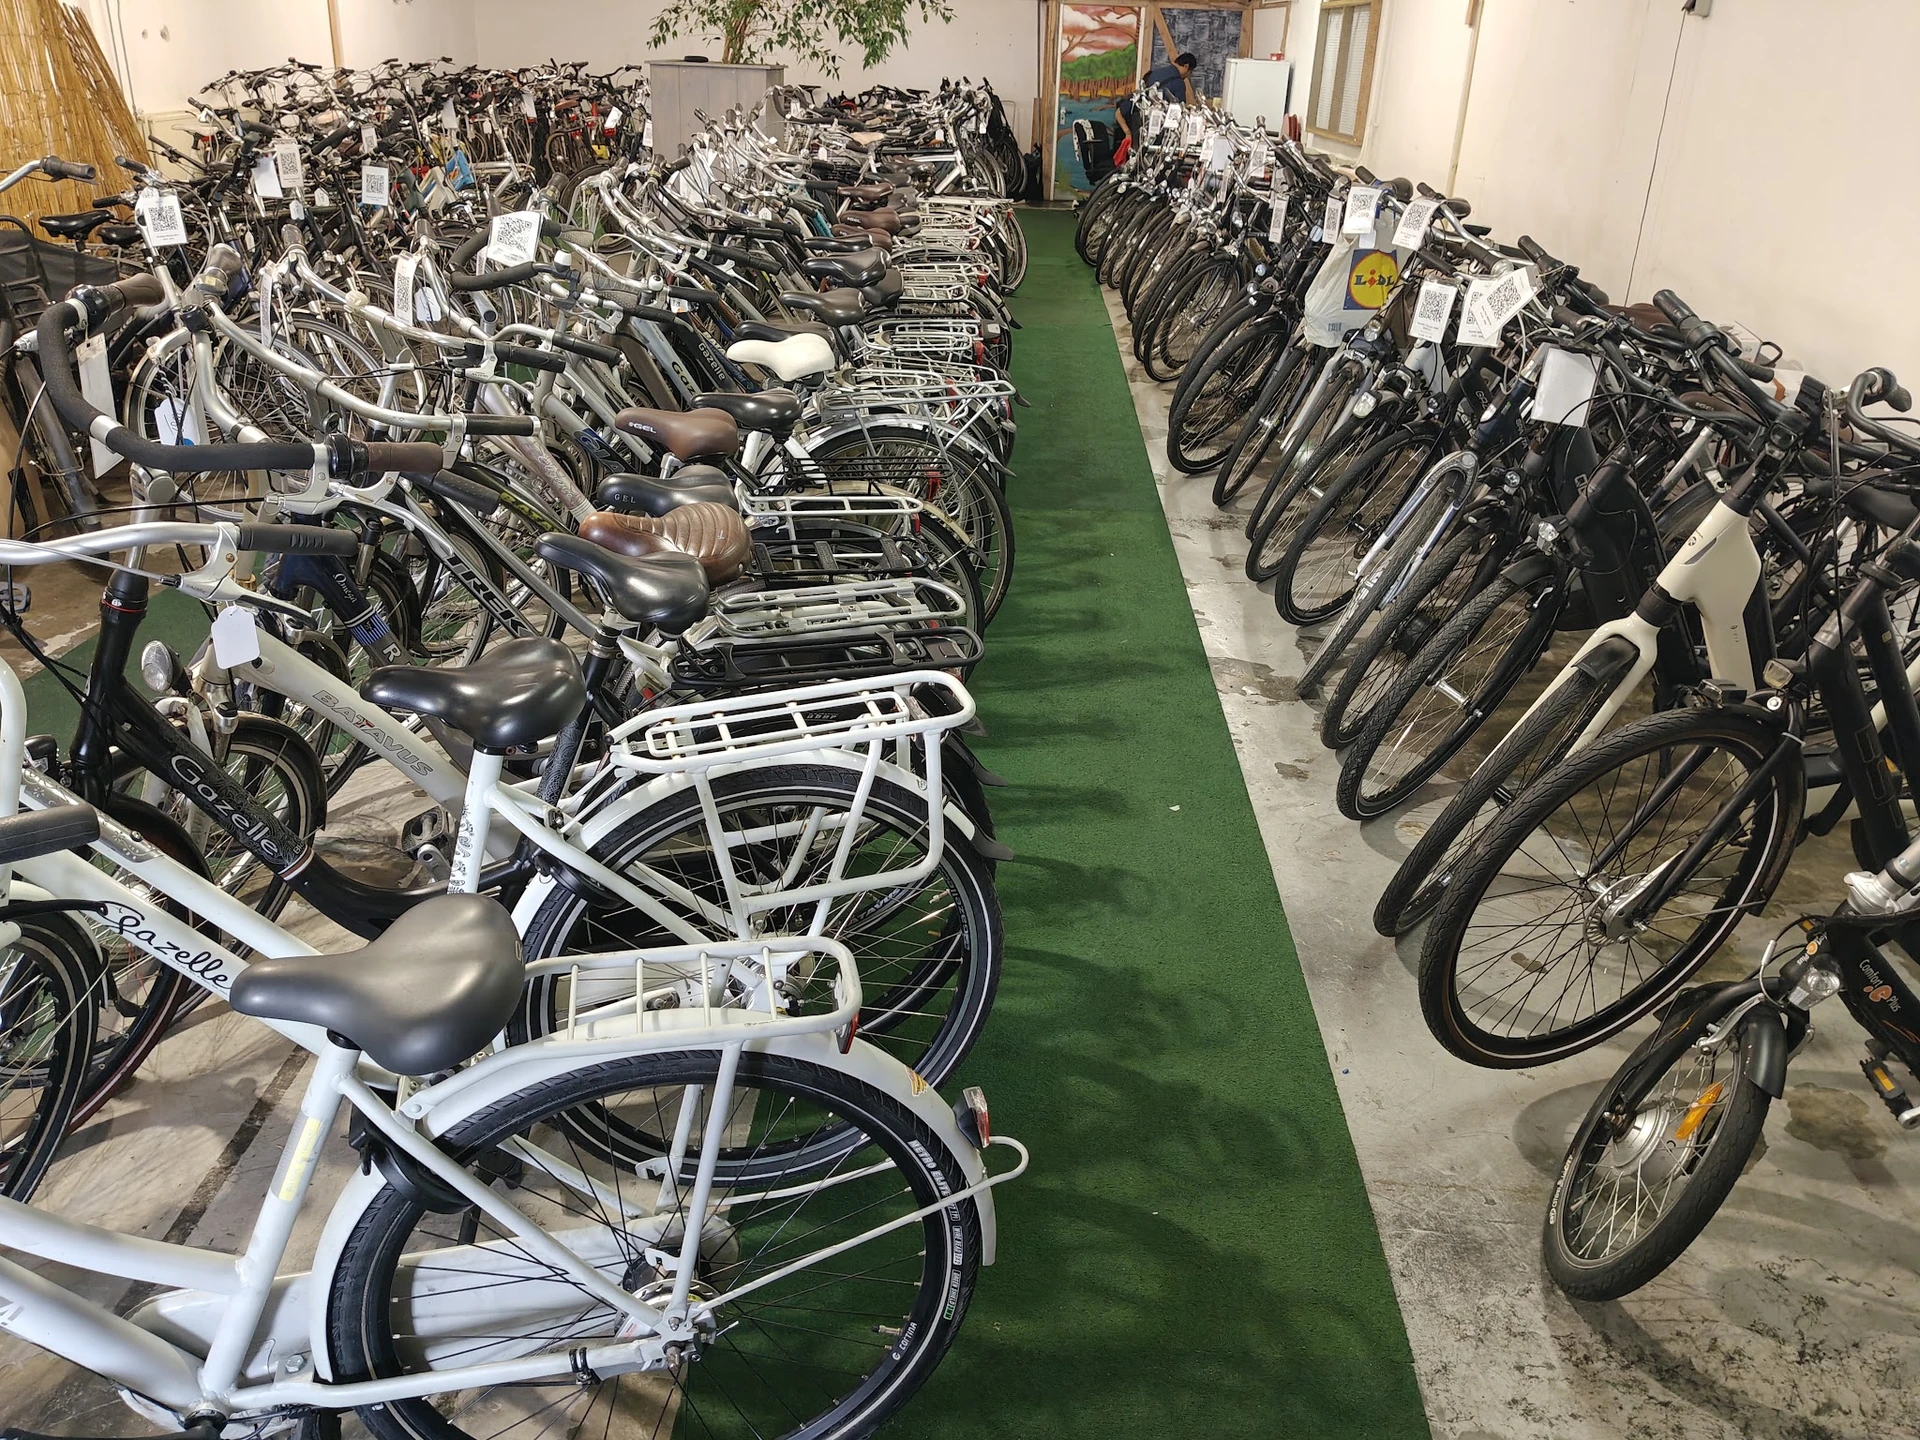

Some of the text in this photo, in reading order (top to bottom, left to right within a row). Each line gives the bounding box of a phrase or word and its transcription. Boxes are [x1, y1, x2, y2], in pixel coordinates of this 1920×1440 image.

[698, 343, 726, 380] Gazelle
[632, 423, 657, 434] GEL
[573, 429, 626, 474] GIA
[500, 491, 556, 532] BATA
[614, 493, 636, 503] GEL
[446, 553, 529, 636] TREK
[312, 690, 434, 776] BATAVUS
[171, 755, 278, 856] Gazelle
[98, 900, 231, 989] Gazelle
[1859, 959, 1884, 988] Comfort
[1886, 995, 1902, 1013] Plus
[907, 1139, 937, 1169] METRO
